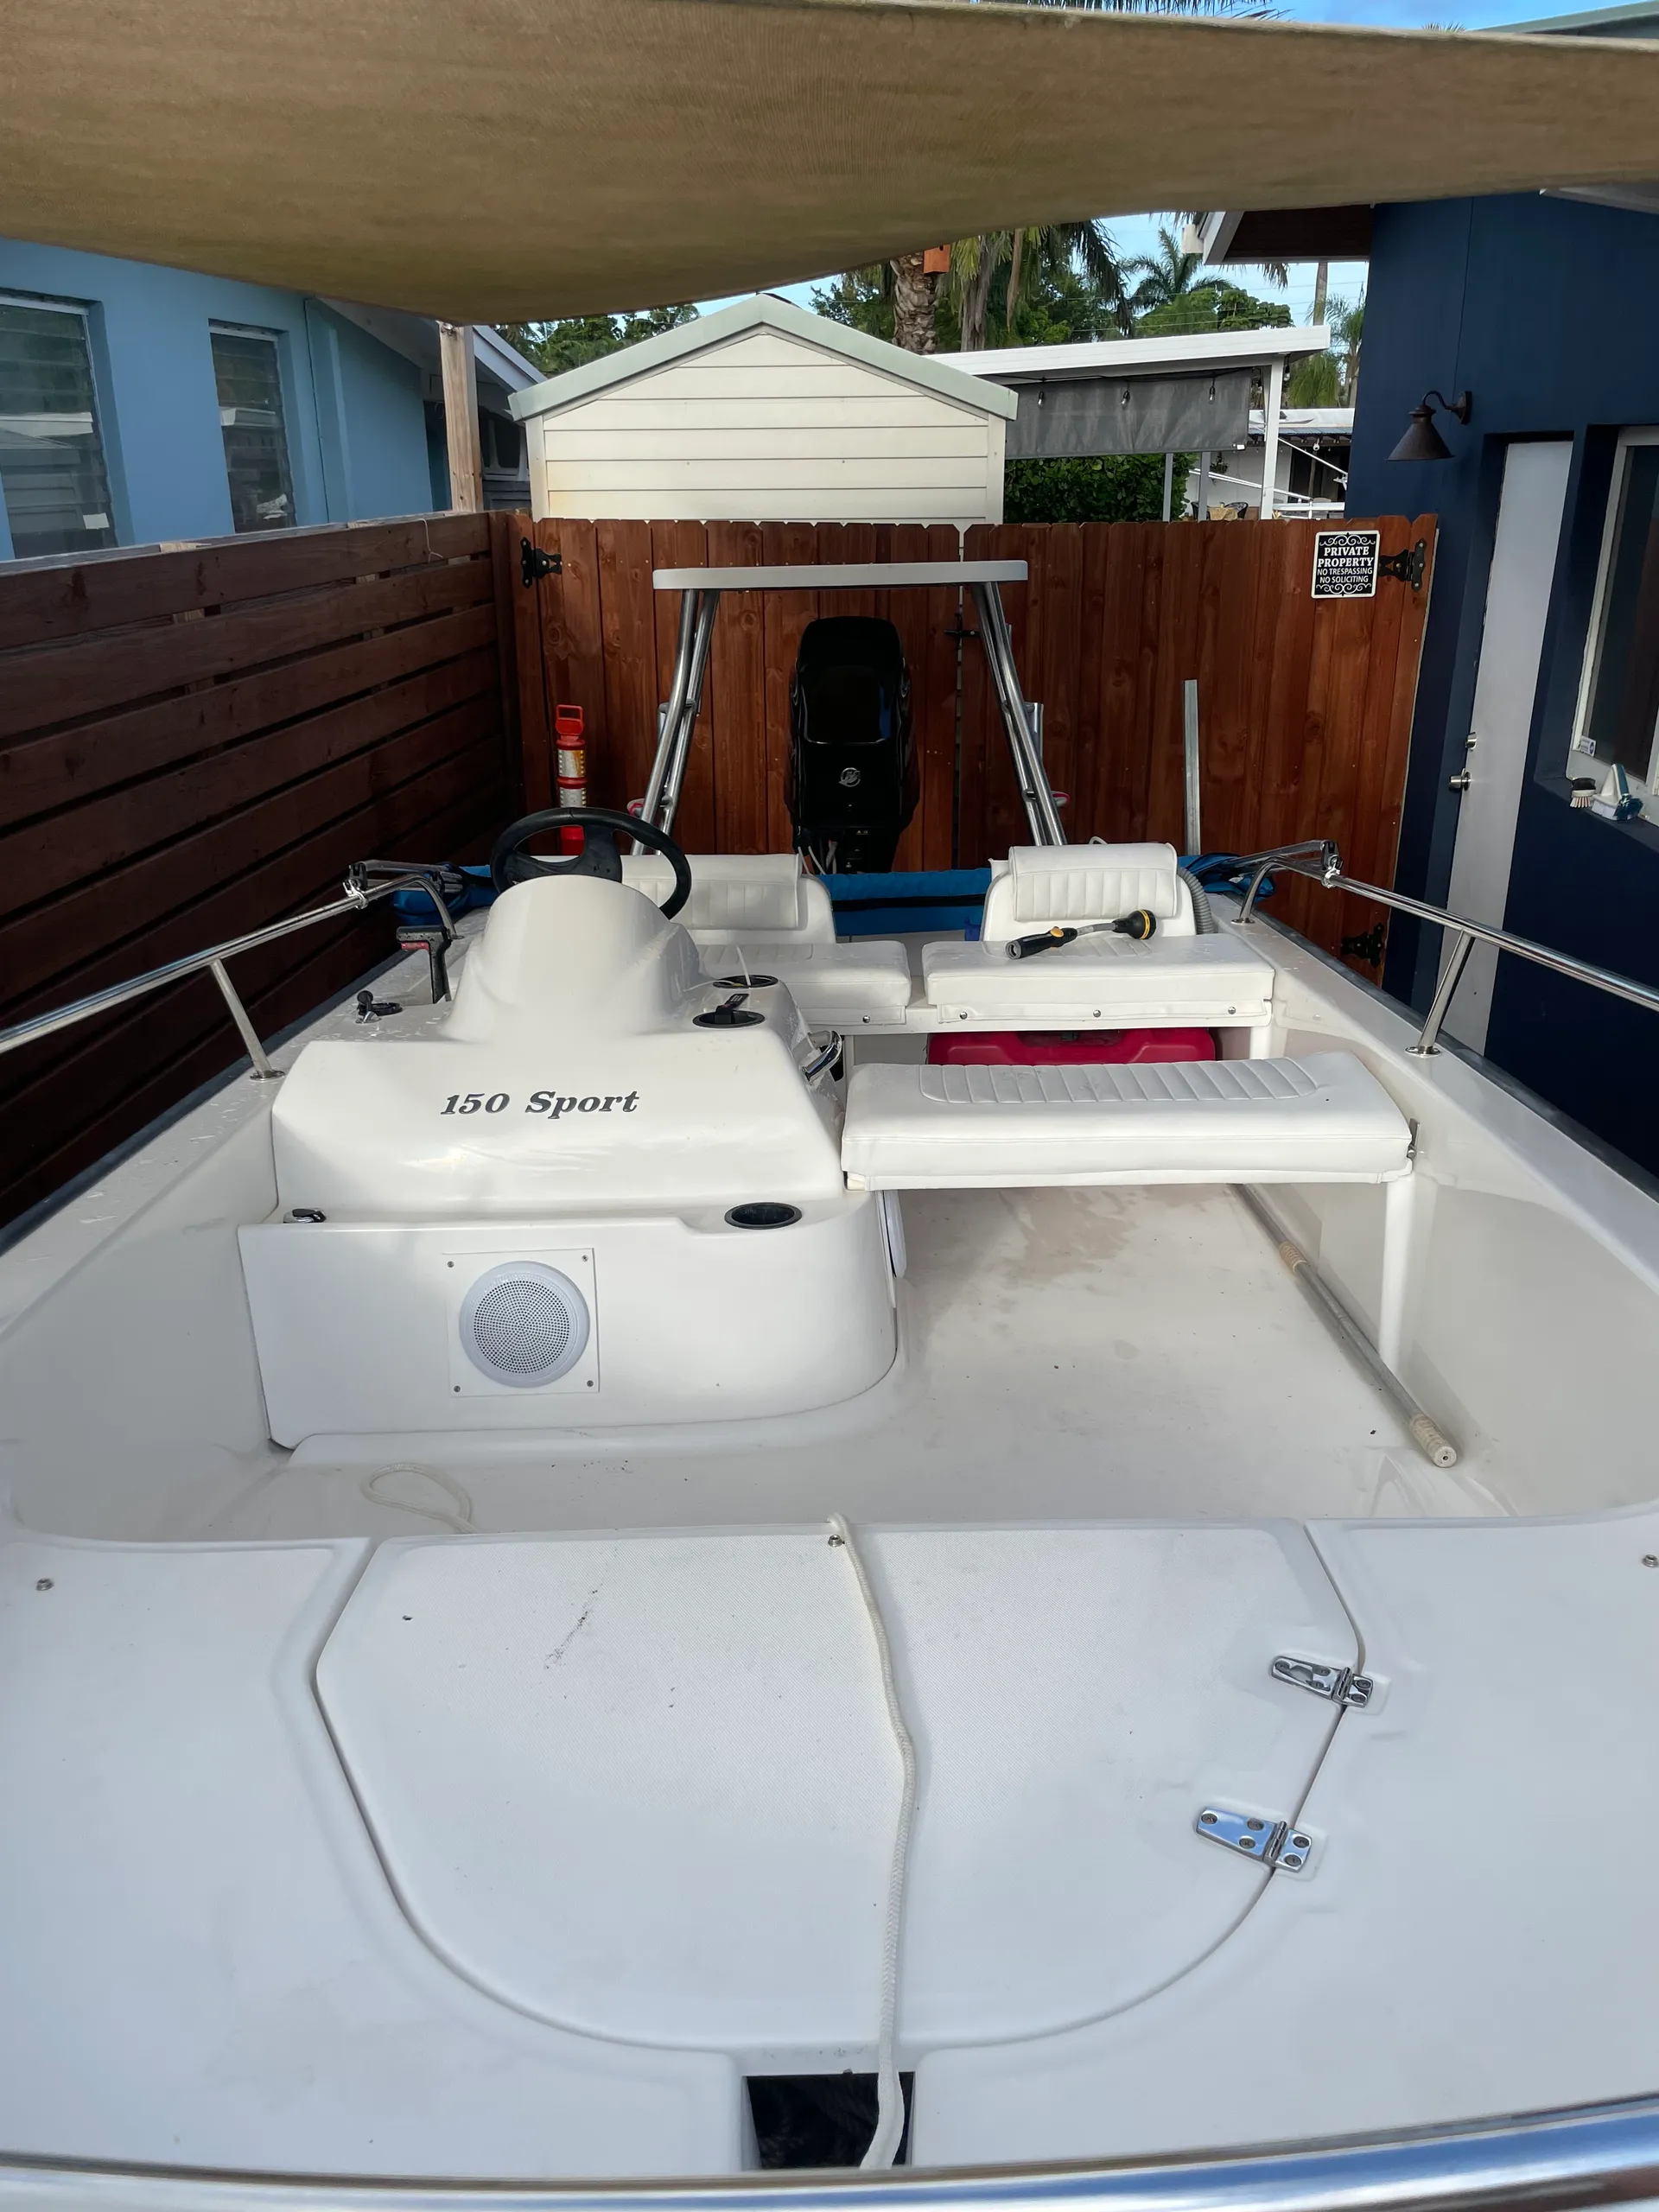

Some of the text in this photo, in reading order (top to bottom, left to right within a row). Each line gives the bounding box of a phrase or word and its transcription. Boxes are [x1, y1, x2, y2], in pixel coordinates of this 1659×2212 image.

[1324, 546, 1370, 556] PRIVATE
[1318, 557, 1374, 567] PROPERTY
[440, 1090, 640, 1120] 150 Sport
